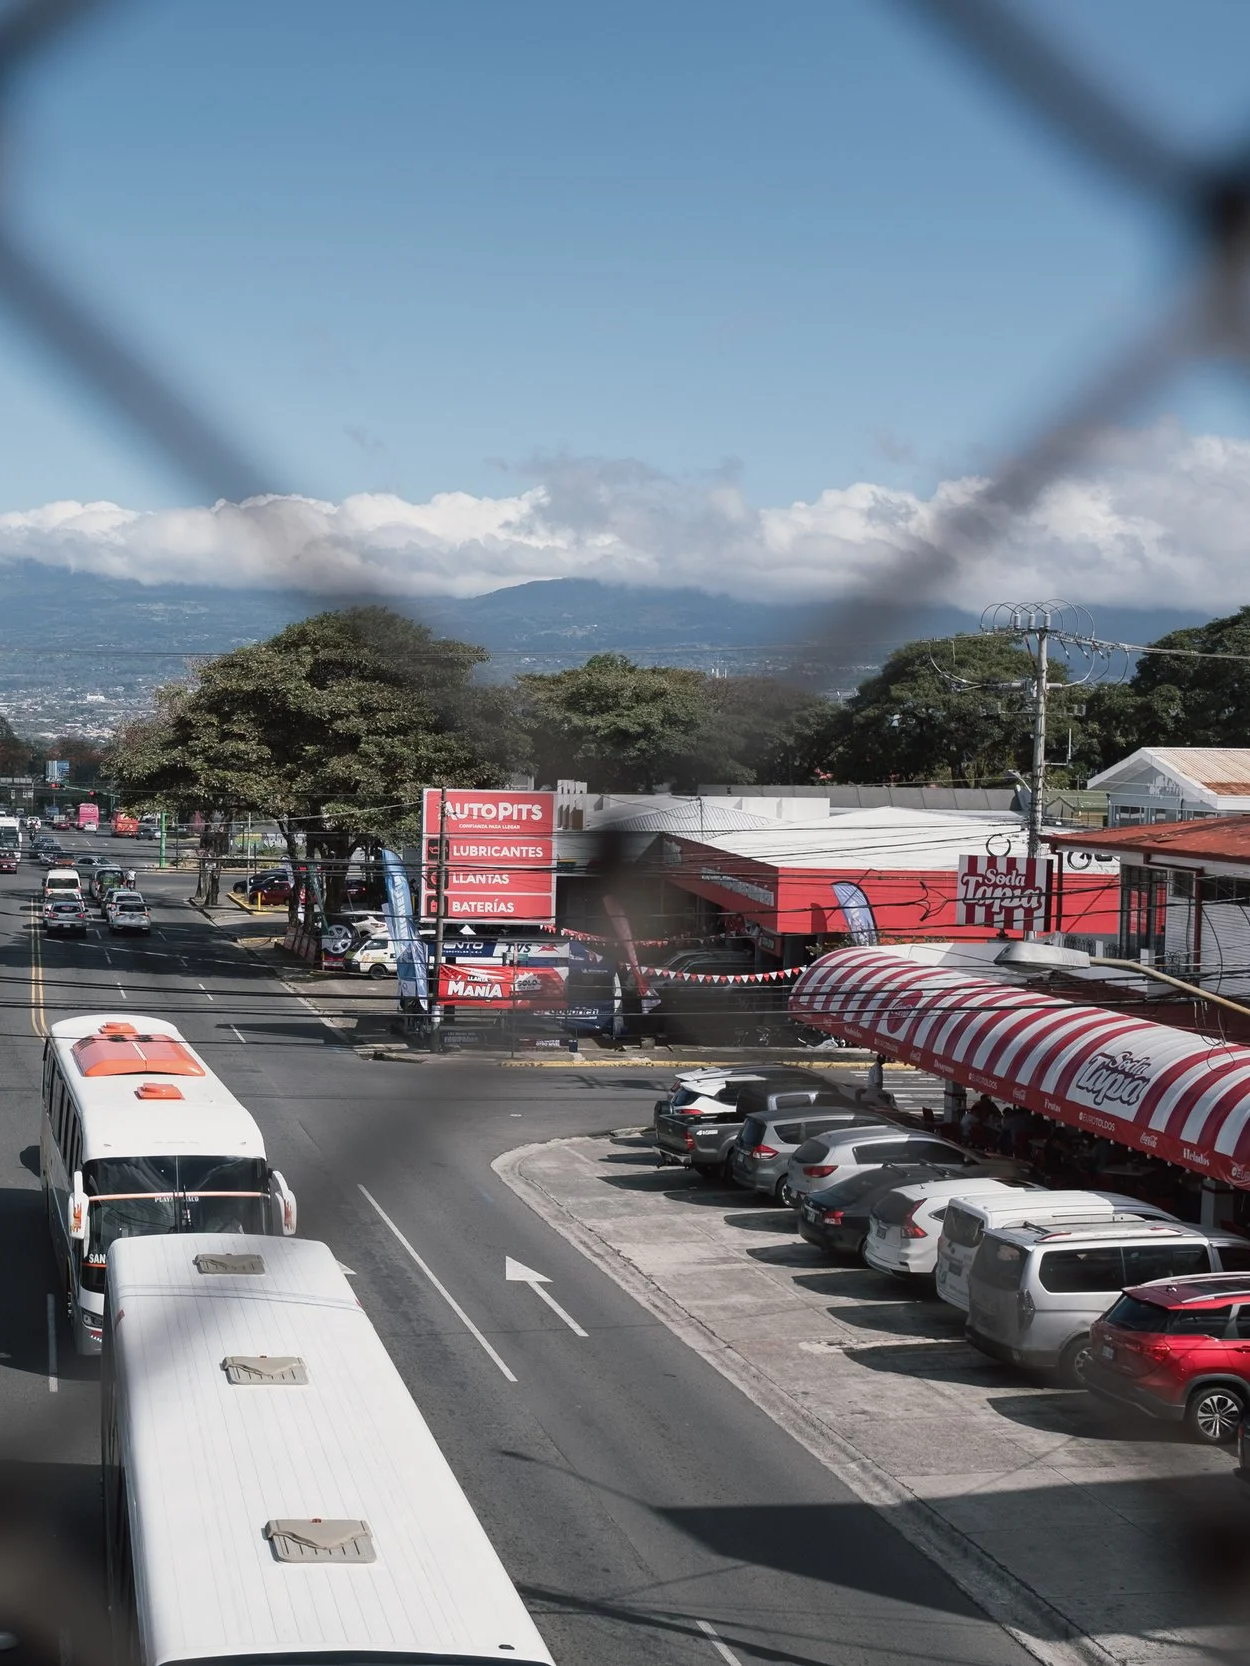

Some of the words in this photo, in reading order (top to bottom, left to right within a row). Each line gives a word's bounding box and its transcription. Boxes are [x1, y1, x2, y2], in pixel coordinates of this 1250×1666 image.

[453, 845, 543, 857] LUBRICANTES
[452, 873, 509, 884] LLANTAS
[985, 868, 1026, 886] Soda
[962, 876, 1040, 912] Tapia
[452, 898, 514, 912] BATERÍAS
[442, 942, 484, 950] ENTO
[505, 943, 532, 953] TVS
[1109, 1052, 1150, 1075] Soda
[1078, 1054, 1149, 1105] Tapia
[1082, 1112, 1116, 1132] EUROTOLDOS
[1183, 1147, 1210, 1167] Helados
[89, 1253, 106, 1264] SAN
